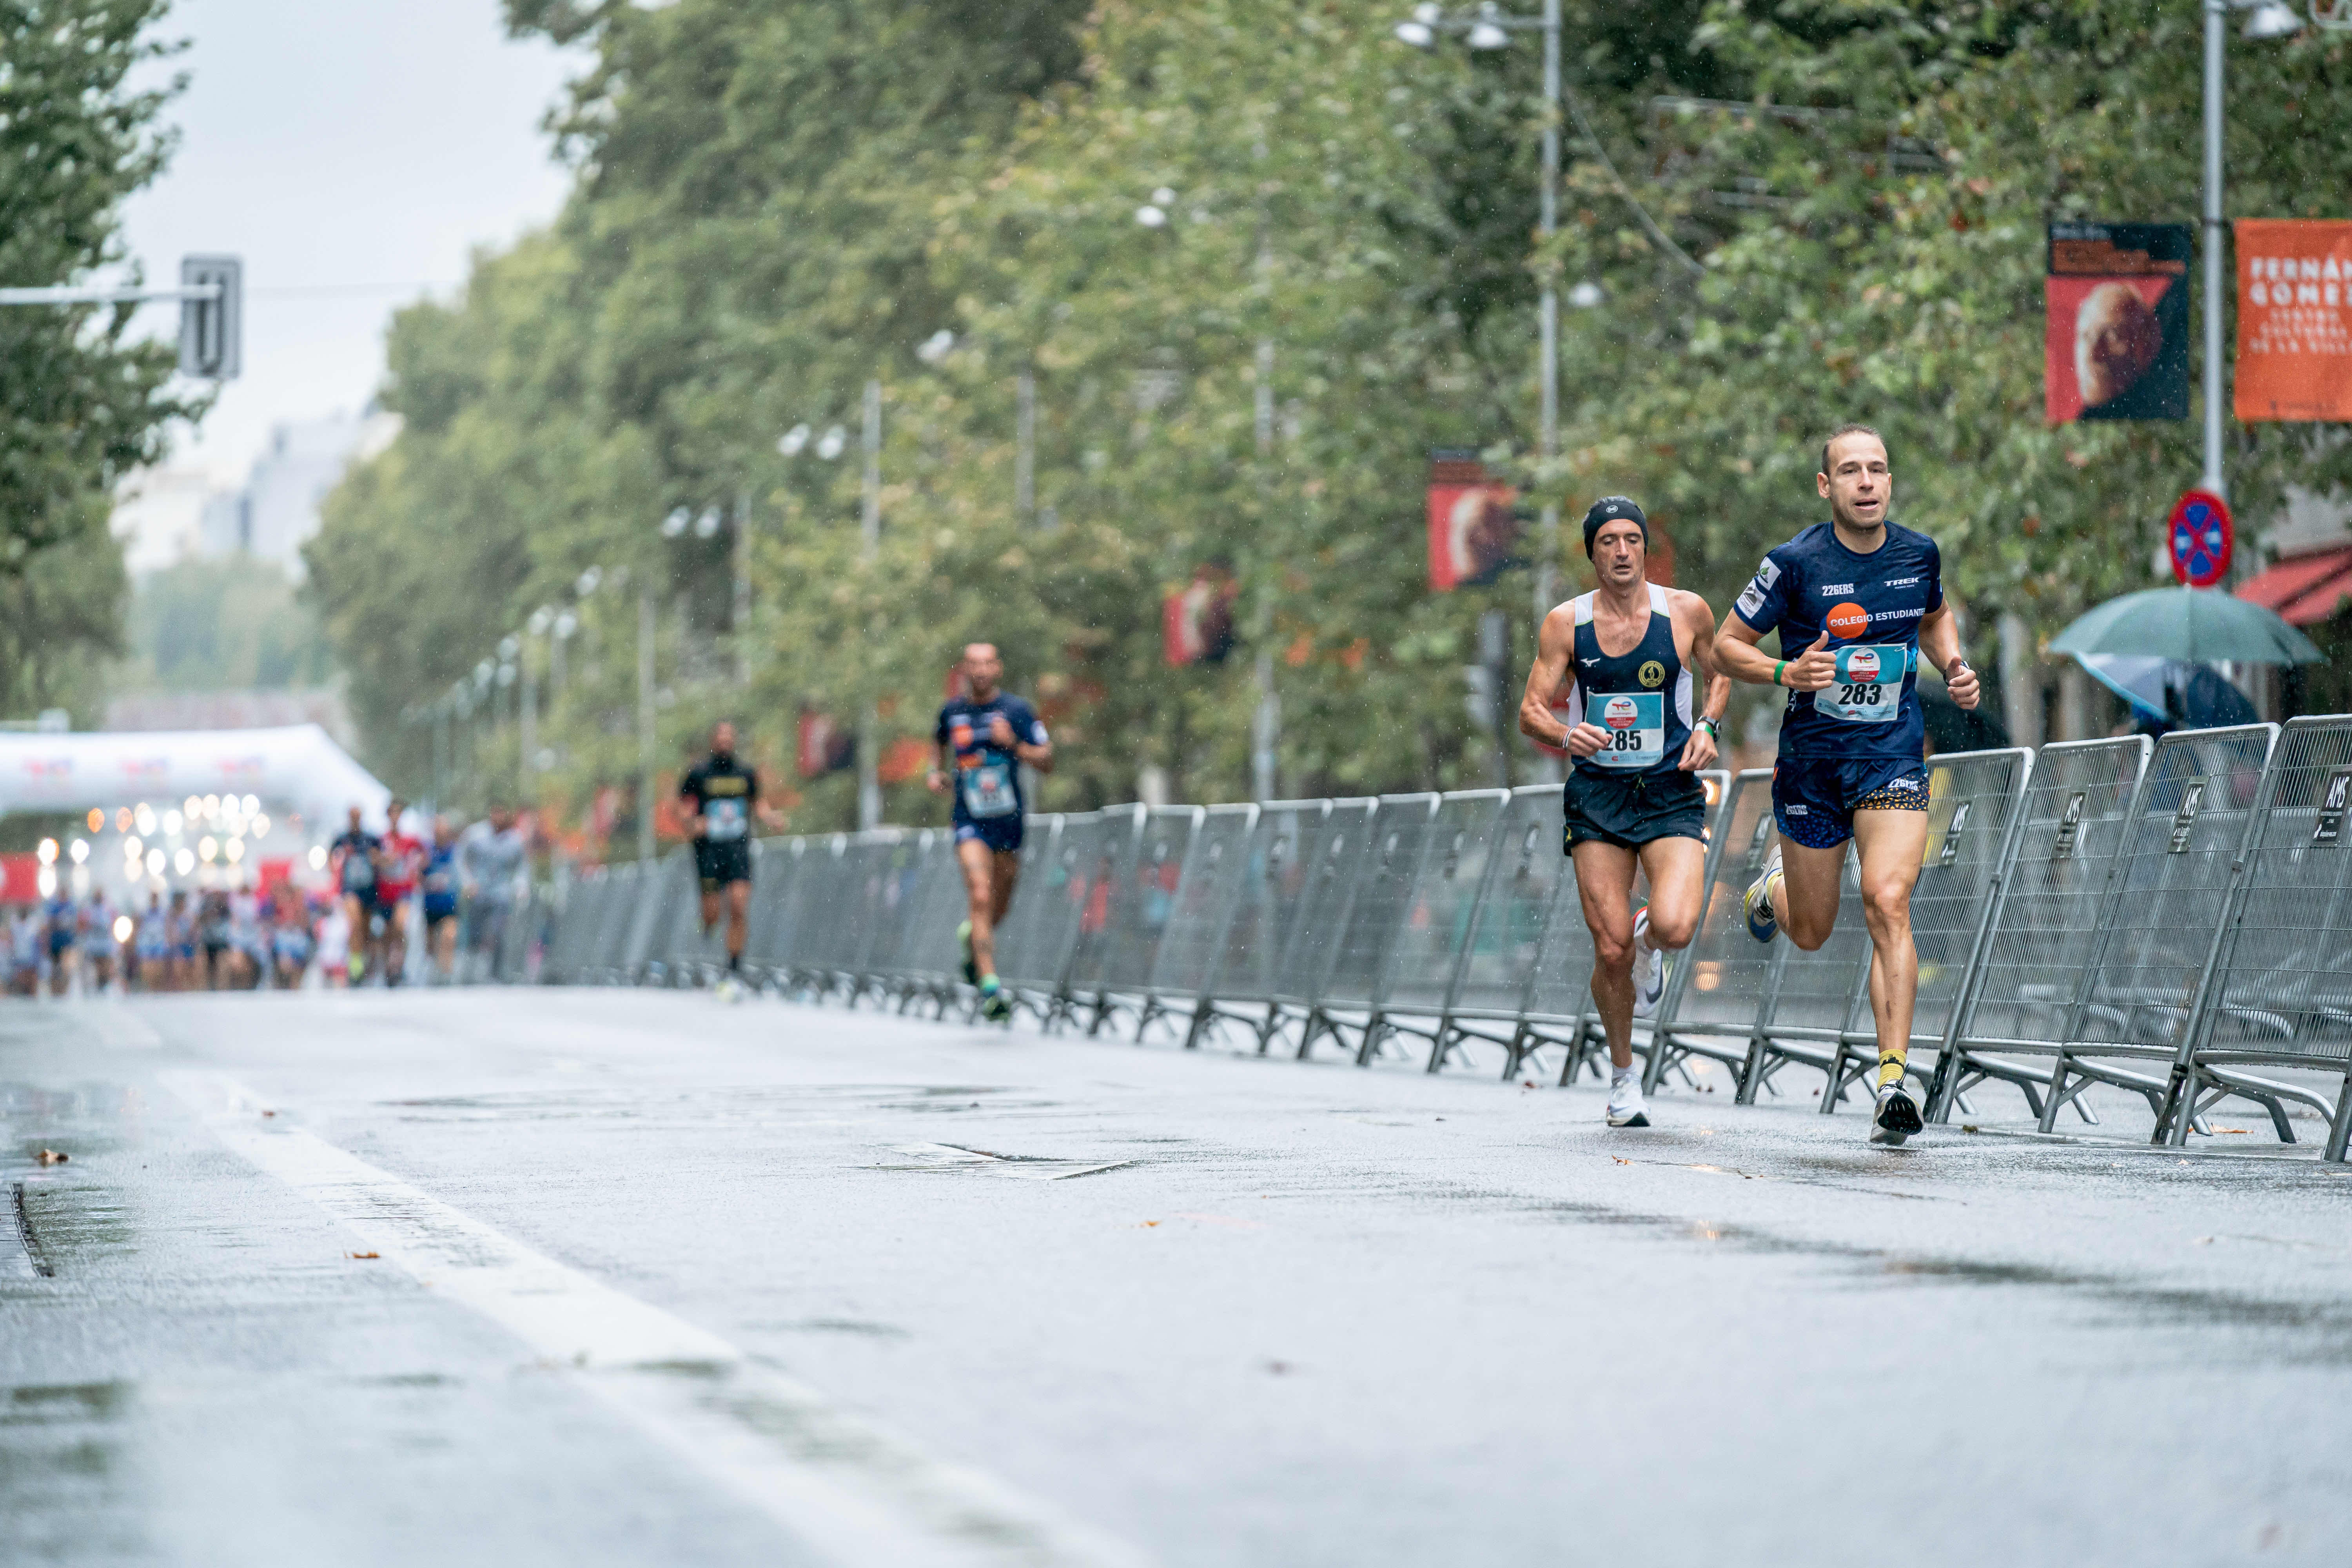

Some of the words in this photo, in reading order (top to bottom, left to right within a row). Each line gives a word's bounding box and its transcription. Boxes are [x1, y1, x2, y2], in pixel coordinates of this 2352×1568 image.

[1822, 583, 1854, 596] 226ERS
[1884, 577, 1919, 586] TREK
[1830, 614, 1873, 627] COLEGIO
[1838, 684, 1882, 706] 283
[2182, 787, 2202, 816] AMS
[2325, 776, 2350, 808] AMS
[1951, 804, 1969, 831] AMS
[2064, 795, 2083, 823] AMS
